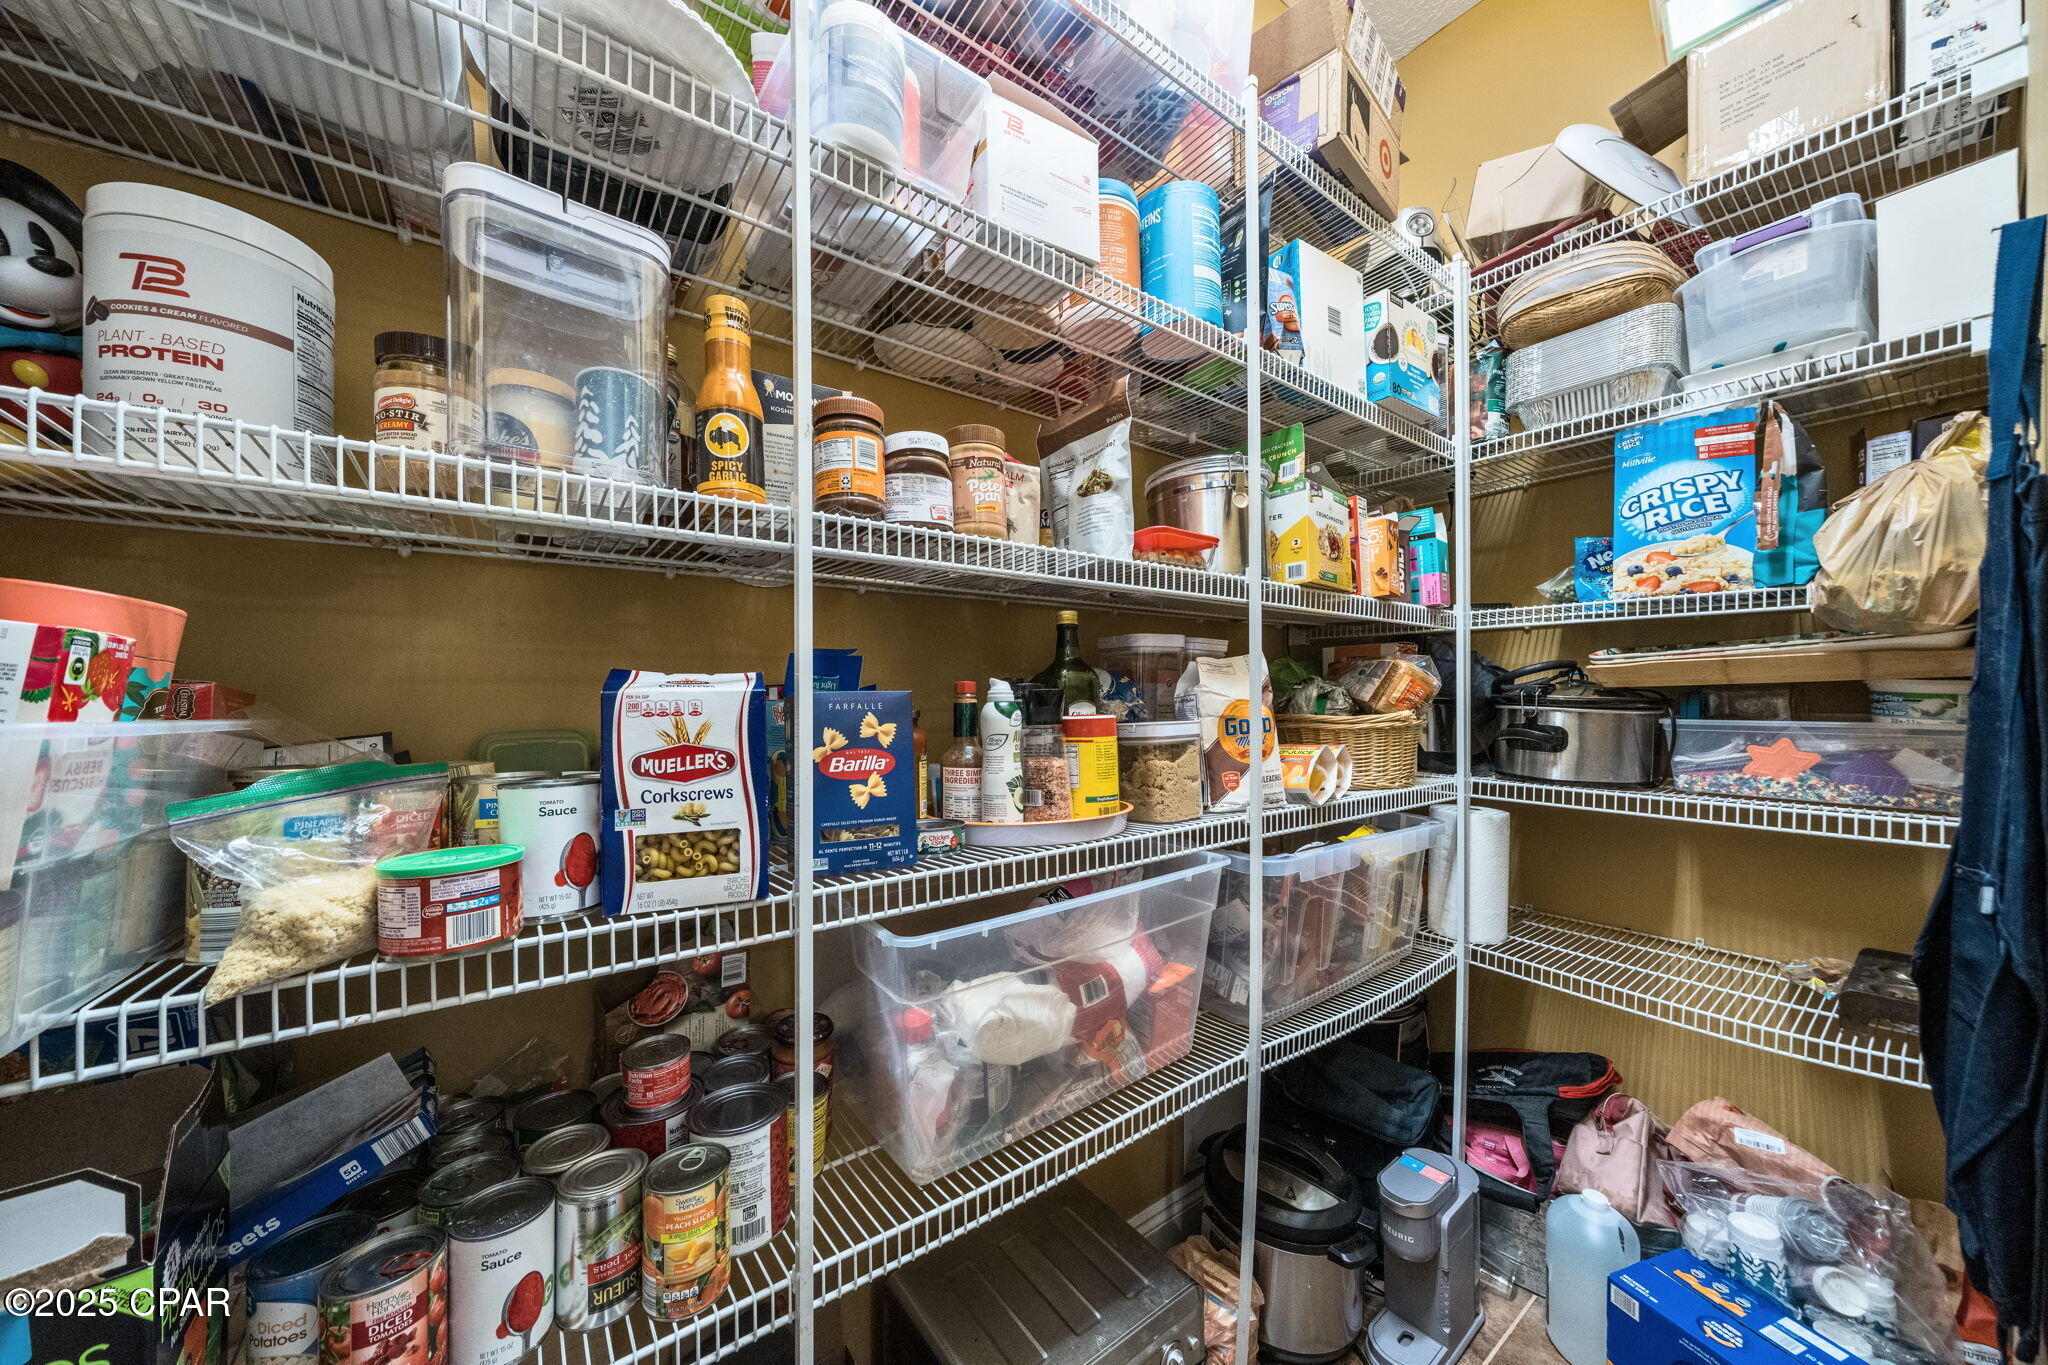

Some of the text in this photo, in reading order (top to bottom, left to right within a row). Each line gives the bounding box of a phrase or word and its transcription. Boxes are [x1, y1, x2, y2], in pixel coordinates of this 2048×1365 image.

[1273, 85, 1294, 100] circle
[1273, 97, 1287, 108] 360
[297, 293, 330, 321] Nutrition
[110, 303, 149, 312] COOKIES
[159, 307, 197, 320] CREAM
[199, 314, 249, 333] FLAVORED
[297, 321, 322, 338] Calories
[98, 329, 226, 355] PLANT BASED
[98, 344, 224, 371] PROTEIN
[157, 378, 184, 389] YELLOW
[185, 382, 204, 391] FIELD
[198, 401, 228, 413] 30
[771, 405, 793, 416] KOSHE
[376, 409, 420, 423] NO-STIR
[381, 421, 409, 429] CREAMY
[1271, 440, 1295, 451] CRACKERS
[1617, 435, 1644, 449] CRISPY
[1623, 441, 1641, 451] RICE
[1268, 448, 1297, 461] CRUNCH
[711, 461, 743, 473] SPICY
[969, 459, 1001, 468] Natural
[1622, 455, 1656, 468] Millville
[709, 471, 747, 483] GARLIC
[1620, 469, 1744, 520] CRISPY
[1316, 510, 1344, 526] CRUNCHMASTER
[1644, 492, 1732, 532] RICE
[829, 702, 883, 710] FARFALLE
[1225, 716, 1272, 736] GOD
[65, 760, 103, 777] BERRY
[641, 751, 729, 776] MUELLER'S
[828, 755, 888, 772] Barilla
[944, 769, 963, 777] THREE
[944, 777, 982, 785] INGREDIENT
[641, 787, 733, 804] Corkscrews
[396, 812, 430, 823] DICED
[538, 806, 577, 817] Sauce
[294, 817, 343, 830] PINEAPPLE
[929, 833, 949, 842] Chicken
[869, 842, 882, 851] 11-12
[727, 876, 749, 885] ENRICHED
[723, 883, 750, 893] MACARONI
[478, 896, 489, 906] 2g
[637, 893, 645, 901] NET
[728, 891, 749, 900] PRODUCT
[637, 901, 643, 909] 16
[666, 896, 678, 906] 454g
[628, 1071, 653, 1080] Nutrition
[628, 1077, 643, 1085] Facts
[344, 1165, 359, 1180] 50
[346, 1169, 368, 1185] SHEETS
[676, 1195, 699, 1207] Sweet
[679, 1198, 707, 1212] Harvest
[665, 1210, 716, 1231] PEACH SLICES
[673, 1213, 691, 1222] YELLOW
[744, 1211, 756, 1221] USA
[229, 1217, 281, 1255] eets
[1382, 1222, 1415, 1245] KEURIG
[482, 1249, 508, 1260] TOMATO
[481, 1251, 523, 1273] Sauce
[593, 1256, 620, 1274] peas
[595, 1268, 616, 1279] SMALL
[593, 1271, 637, 1305] SUEUR
[367, 1289, 399, 1311] Happy
[372, 1293, 413, 1317] Harvest
[257, 1313, 308, 1335] Diced
[368, 1308, 414, 1338] DICED
[372, 1316, 387, 1325] FIRE
[369, 1317, 414, 1344] TOMATOES
[250, 1329, 308, 1349] Potatoes
